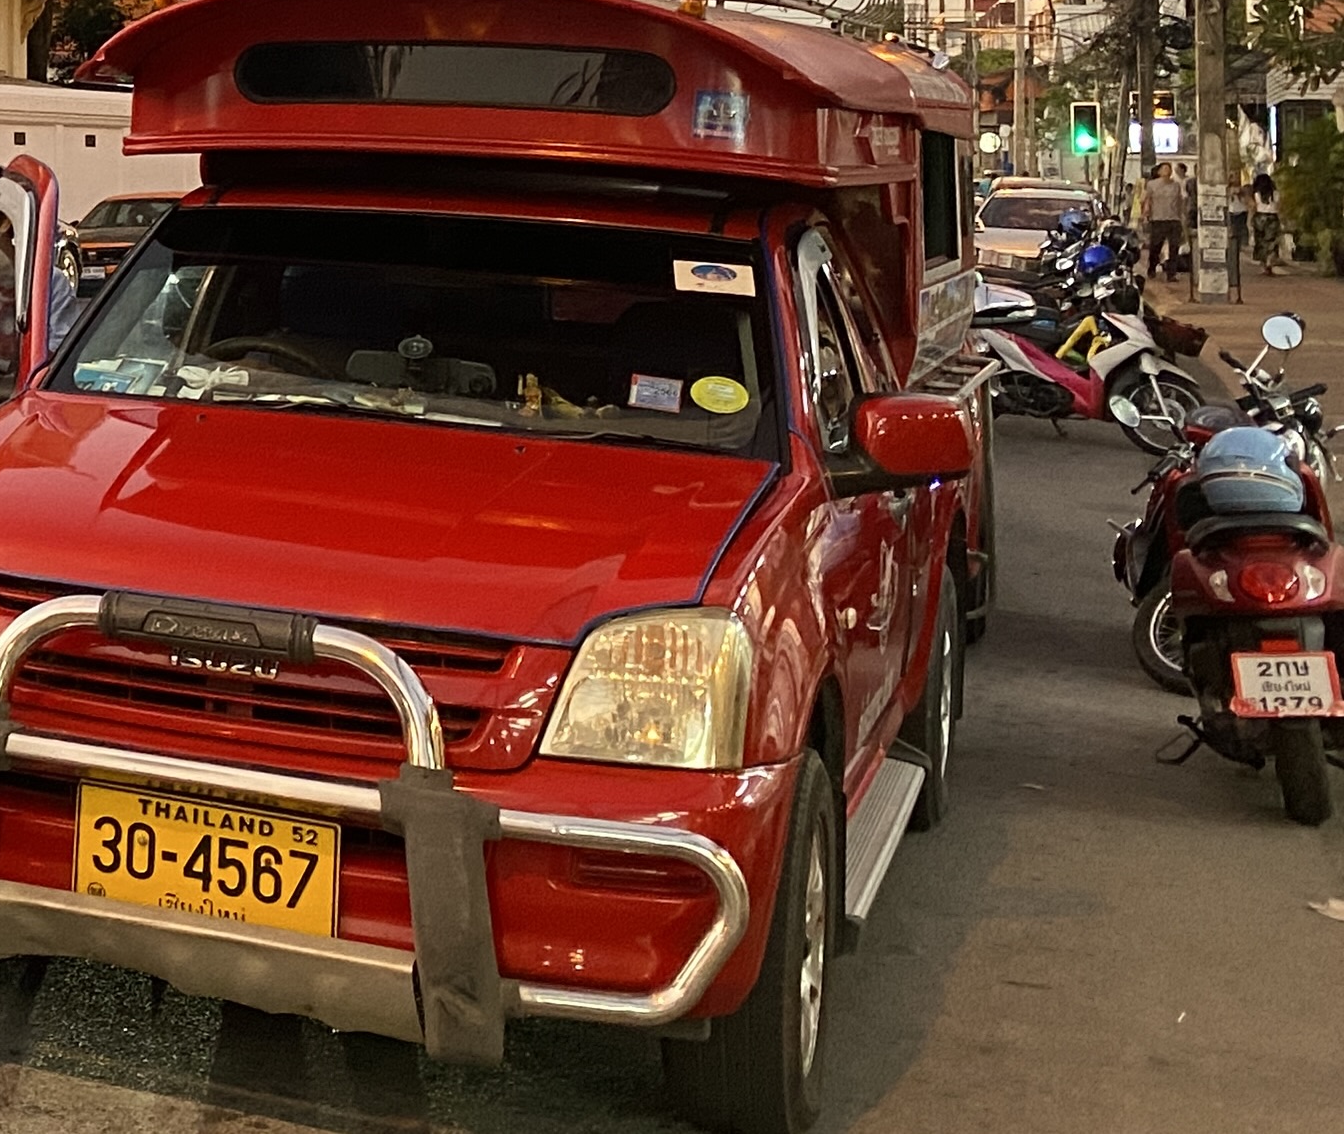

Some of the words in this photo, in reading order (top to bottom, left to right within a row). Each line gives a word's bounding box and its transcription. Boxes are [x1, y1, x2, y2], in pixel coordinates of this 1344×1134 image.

[138, 798, 275, 837] THAILAND
[292, 826, 319, 846] 52
[92, 815, 319, 909] 30-4567
